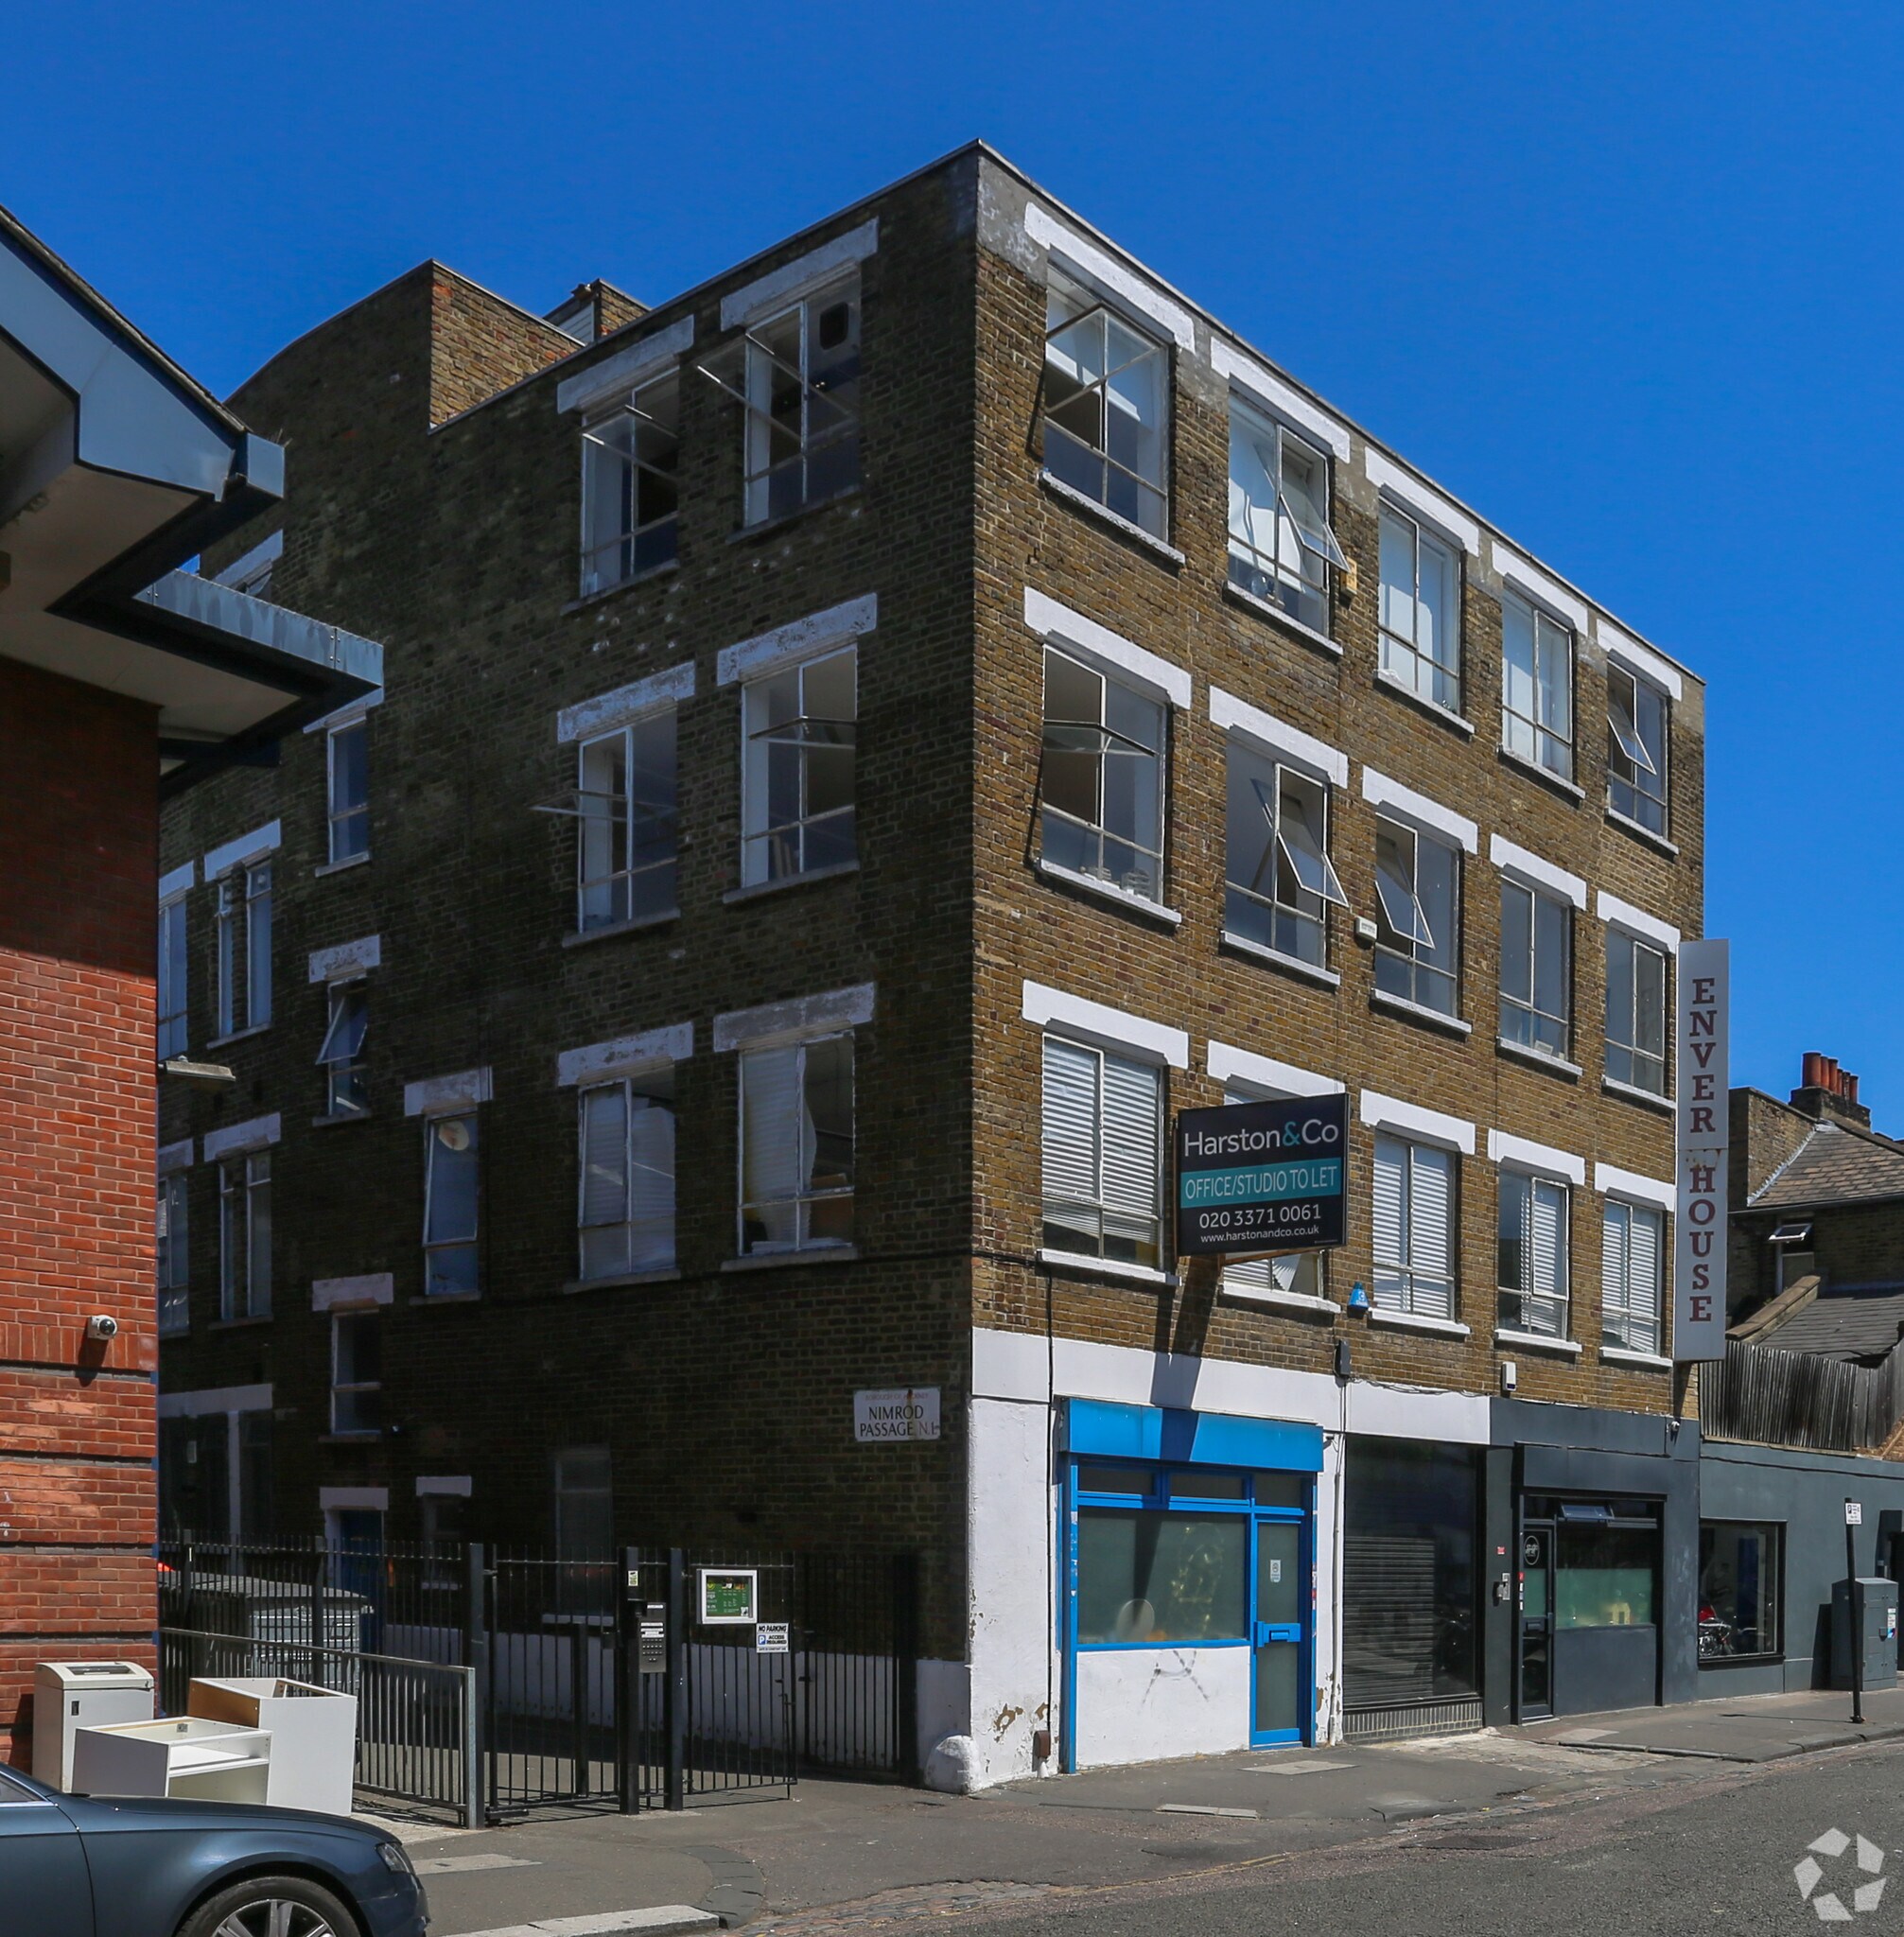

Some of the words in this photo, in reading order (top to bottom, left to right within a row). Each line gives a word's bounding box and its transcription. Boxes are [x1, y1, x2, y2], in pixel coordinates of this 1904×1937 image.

[1689, 977, 1717, 1133] ENVER
[1184, 1119, 1339, 1157] Harston&Co
[1185, 1170, 1287, 1199] OFFICE/STUDIO
[1289, 1168, 1309, 1190] TO
[1311, 1166, 1337, 1188] LET
[1198, 1212, 1231, 1229] 020
[1233, 1208, 1275, 1226] 3371
[1280, 1204, 1321, 1222] 0061
[1200, 1224, 1319, 1243] www.harstonandco.co.uk
[1688, 1164, 1716, 1322] HOUSE
[868, 1405, 924, 1421] NIMROD
[860, 1422, 914, 1437] PASSAGE
